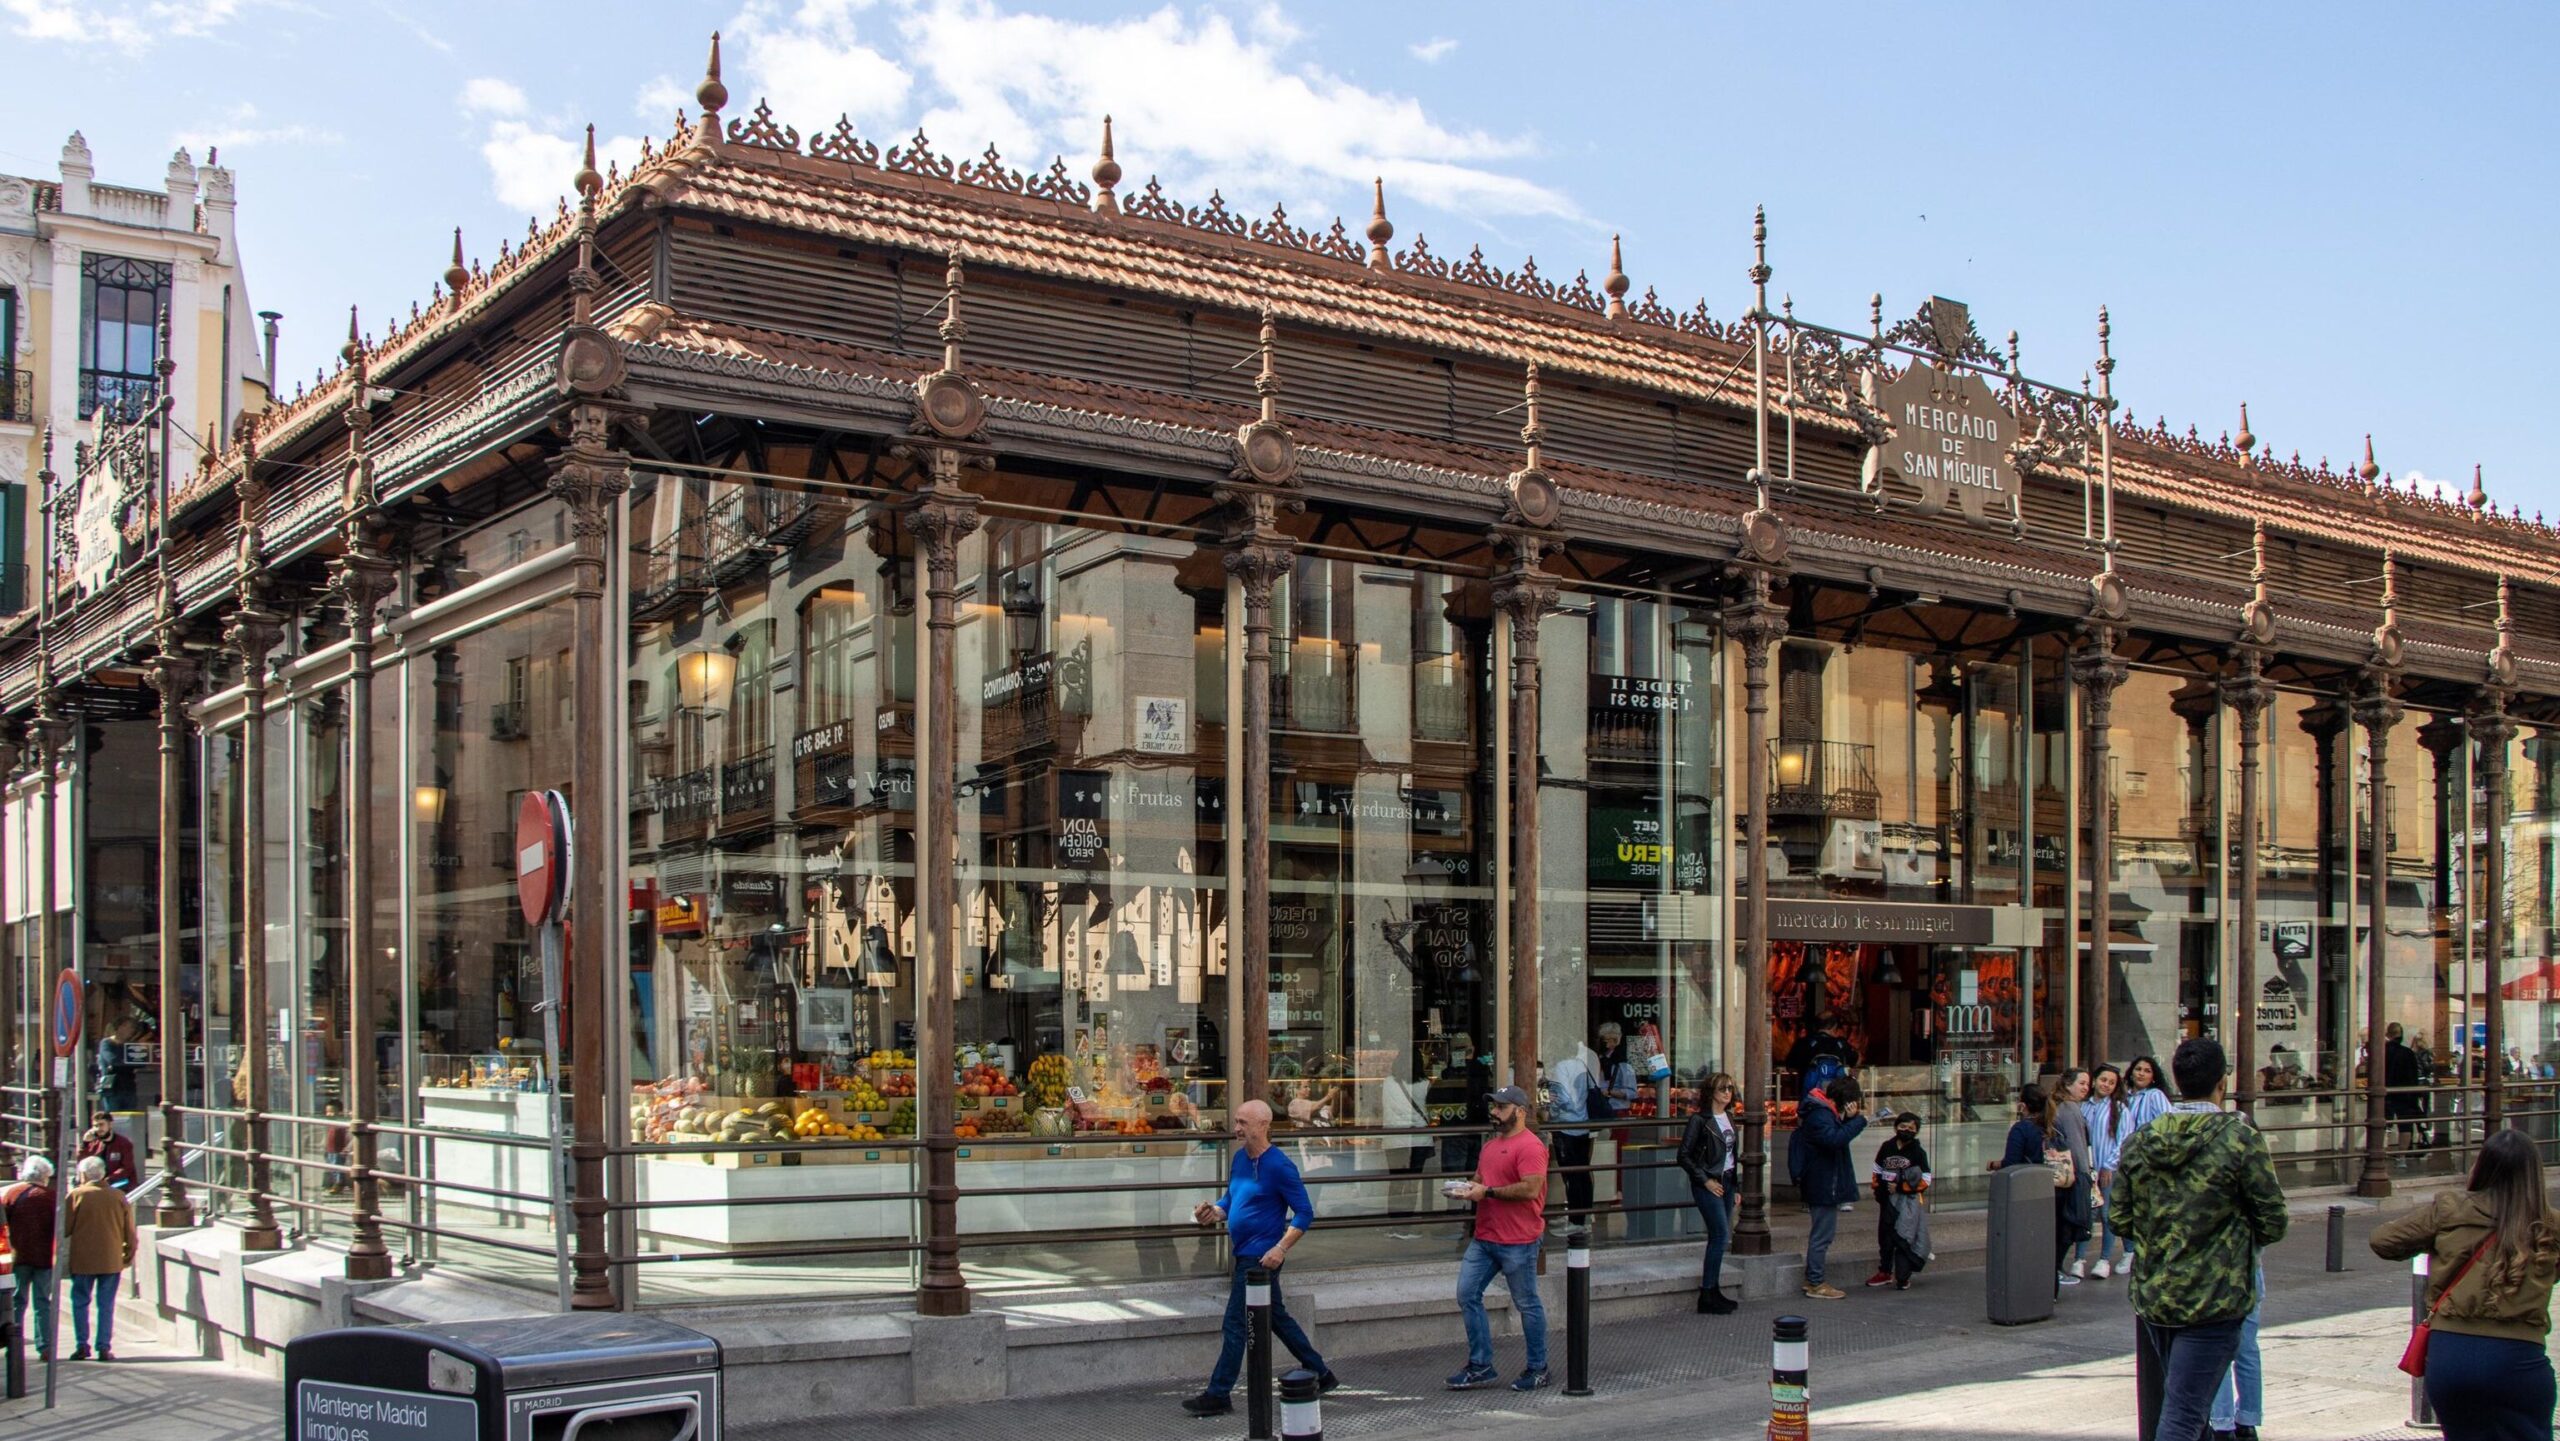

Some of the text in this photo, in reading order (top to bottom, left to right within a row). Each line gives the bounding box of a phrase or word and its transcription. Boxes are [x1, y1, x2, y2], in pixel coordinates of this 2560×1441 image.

[1905, 402, 1998, 442] MERCADO
[1942, 438, 1965, 455] DE
[1904, 451, 2004, 491] SAN MIGUEL
[1127, 786, 1183, 807] Frutas
[1340, 797, 1413, 820] Verduras
[1777, 908, 1955, 939] mercado de san miguel
[306, 1391, 428, 1428] Mantener Madrid
[524, 1397, 562, 1411] MADRID
[306, 1417, 370, 1441] limpio es
